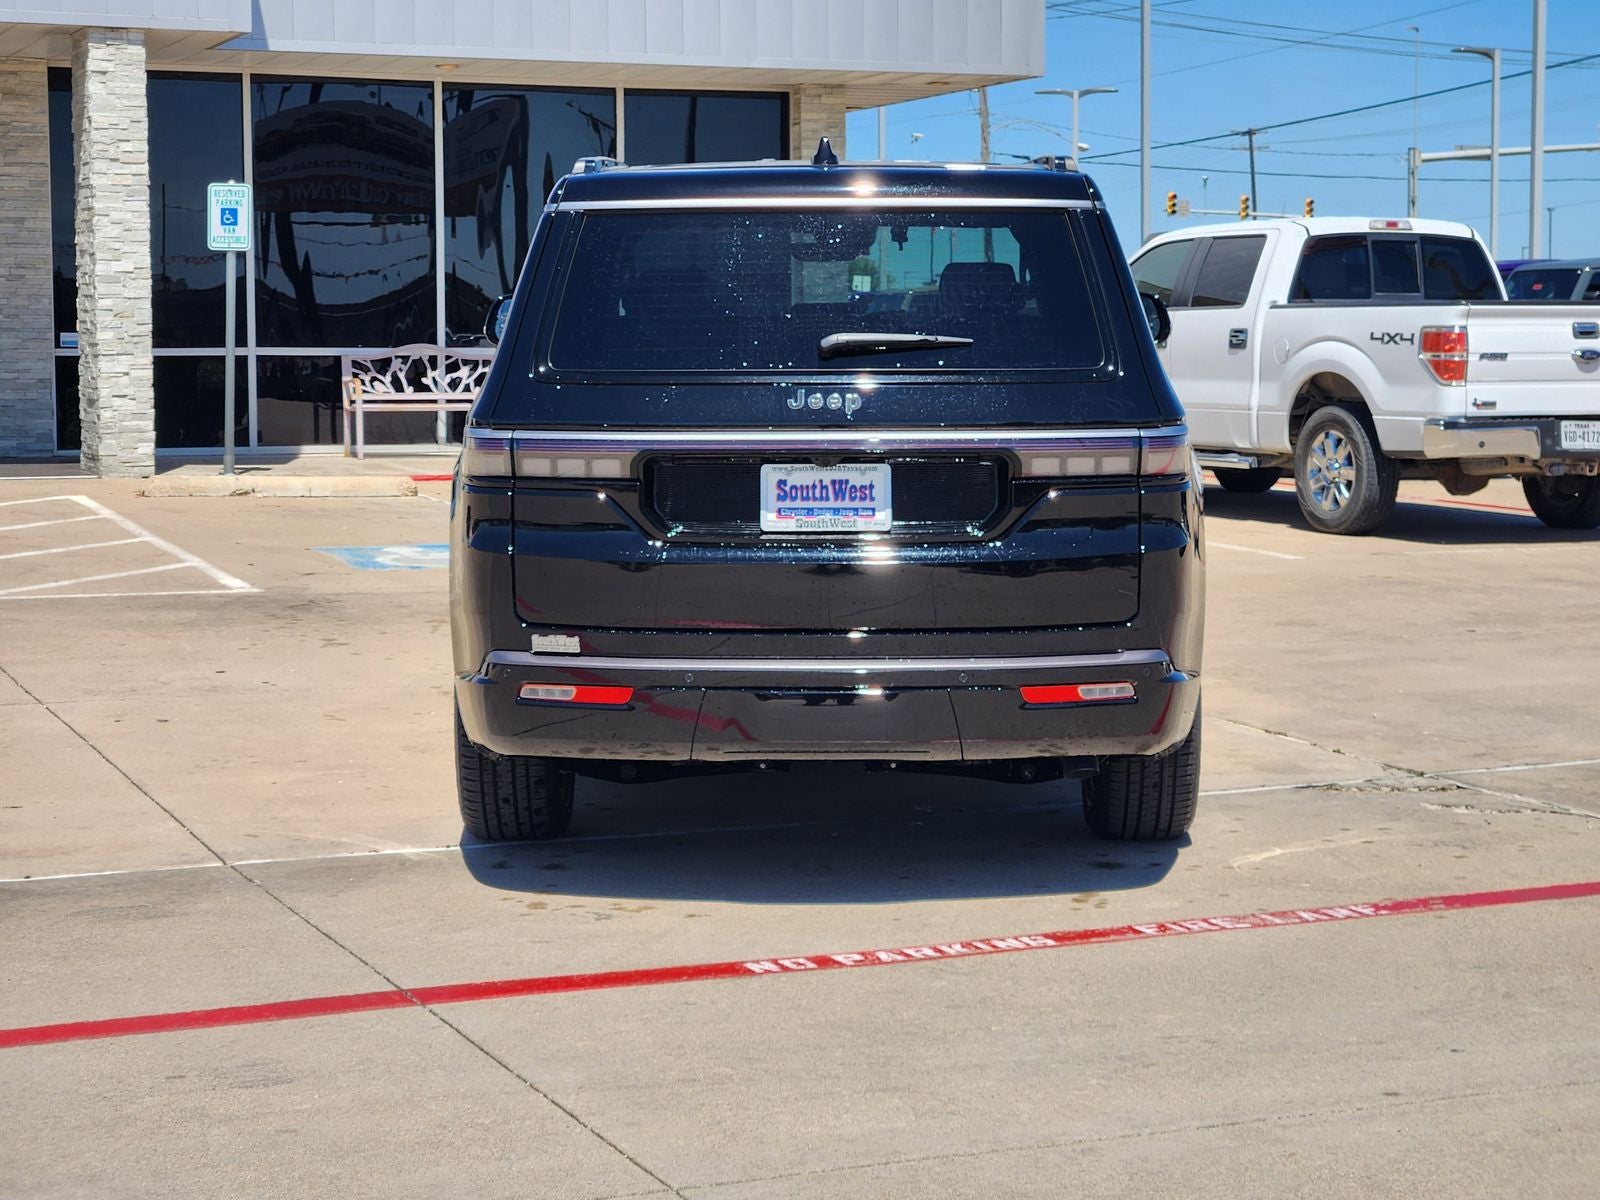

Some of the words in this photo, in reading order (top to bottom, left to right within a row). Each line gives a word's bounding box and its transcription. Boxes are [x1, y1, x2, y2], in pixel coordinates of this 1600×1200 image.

[213, 189, 246, 198] RESERVED
[215, 198, 243, 207] PARKING
[212, 235, 247, 244] ACCESSIBLE
[786, 389, 862, 415] Jeep
[776, 478, 875, 502] SouthWest
[781, 508, 808, 516] Chrysler
[839, 508, 854, 516] Jeep
[795, 518, 858, 529] SouthWest
[743, 957, 819, 974] NO
[828, 935, 1057, 966] PARKING
[1131, 916, 1251, 937] FIRE
[1257, 903, 1378, 924] LANE
